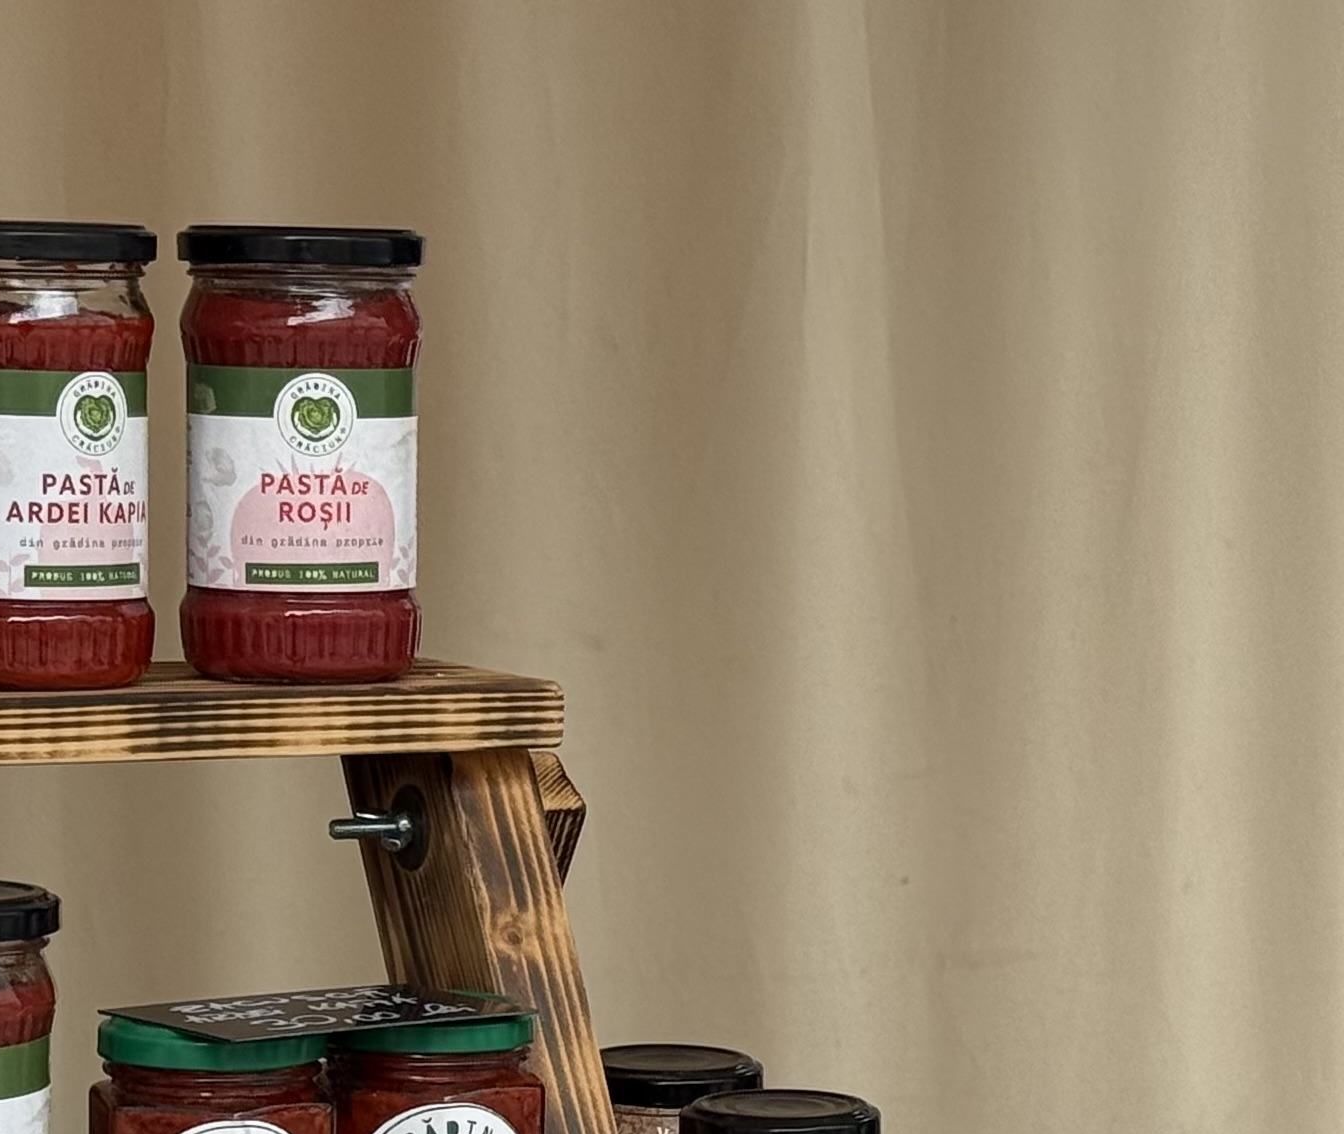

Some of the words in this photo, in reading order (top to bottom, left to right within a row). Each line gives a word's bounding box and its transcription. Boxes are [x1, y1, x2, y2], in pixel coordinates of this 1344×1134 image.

[41, 466, 121, 496] PASTĂ
[122, 480, 136, 496] DE
[260, 466, 347, 496] PASTĂ
[350, 480, 370, 496] DE
[5, 500, 89, 524] ARDEI
[278, 501, 351, 531] ROȘII
[19, 536, 44, 549] din
[52, 536, 106, 550] grădina
[240, 535, 264, 547] din
[270, 534, 328, 549] grădina
[335, 537, 384, 549] proprie
[79, 570, 106, 583] 100%
[298, 569, 328, 581] 100%
[331, 569, 375, 580] NATURAL
